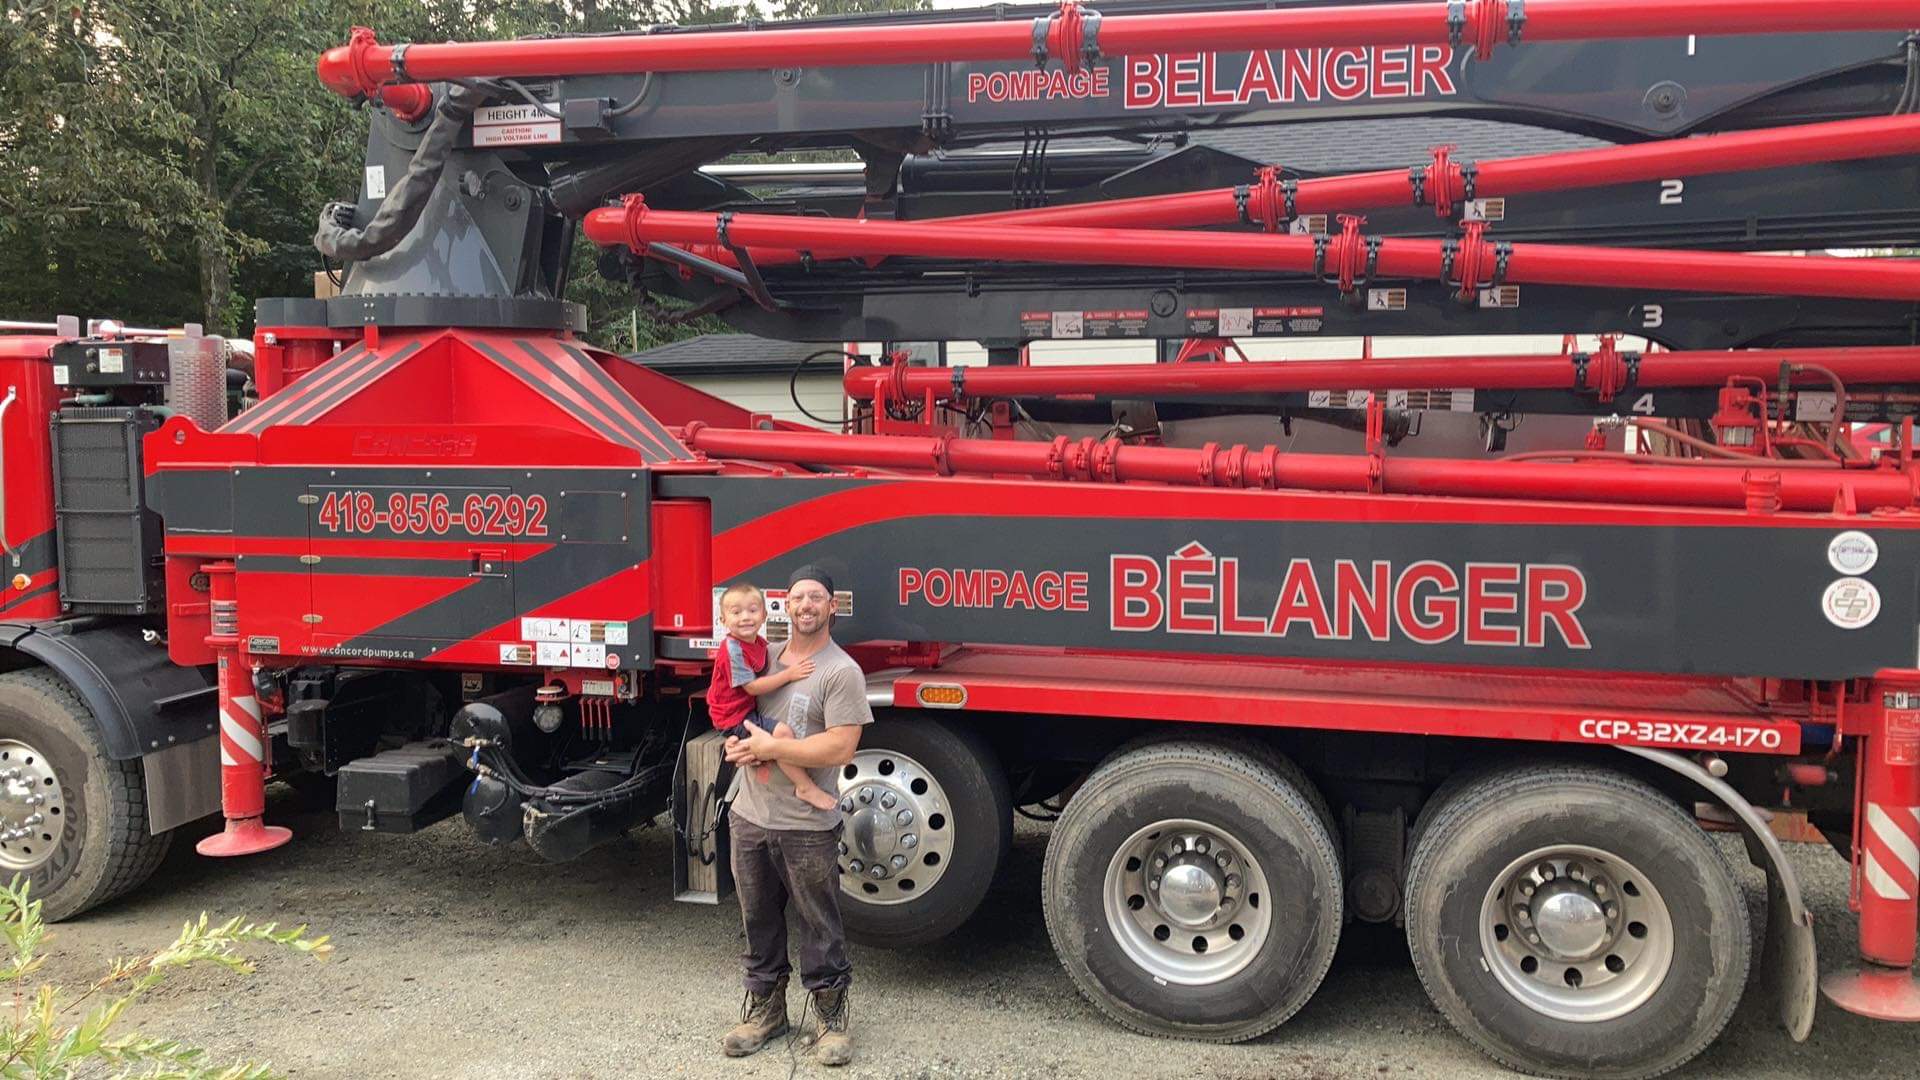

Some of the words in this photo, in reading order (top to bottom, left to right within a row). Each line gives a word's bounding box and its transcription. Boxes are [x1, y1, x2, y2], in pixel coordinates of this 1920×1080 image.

[968, 66, 1110, 103] POMPAGE
[487, 109, 528, 121] HEIGHT
[503, 134, 532, 142] VOLTAGE
[1659, 179, 1684, 205] 2
[1642, 304, 1663, 328] 3
[1632, 393, 1656, 415] 4
[318, 491, 548, 536] 418-856-6292
[899, 567, 1089, 612] POMPAGE
[1110, 540, 1592, 649] BÊLANGER
[301, 645, 415, 659] www.concordpumps.ca
[1579, 718, 1782, 749] CCP-32XZ4-170
